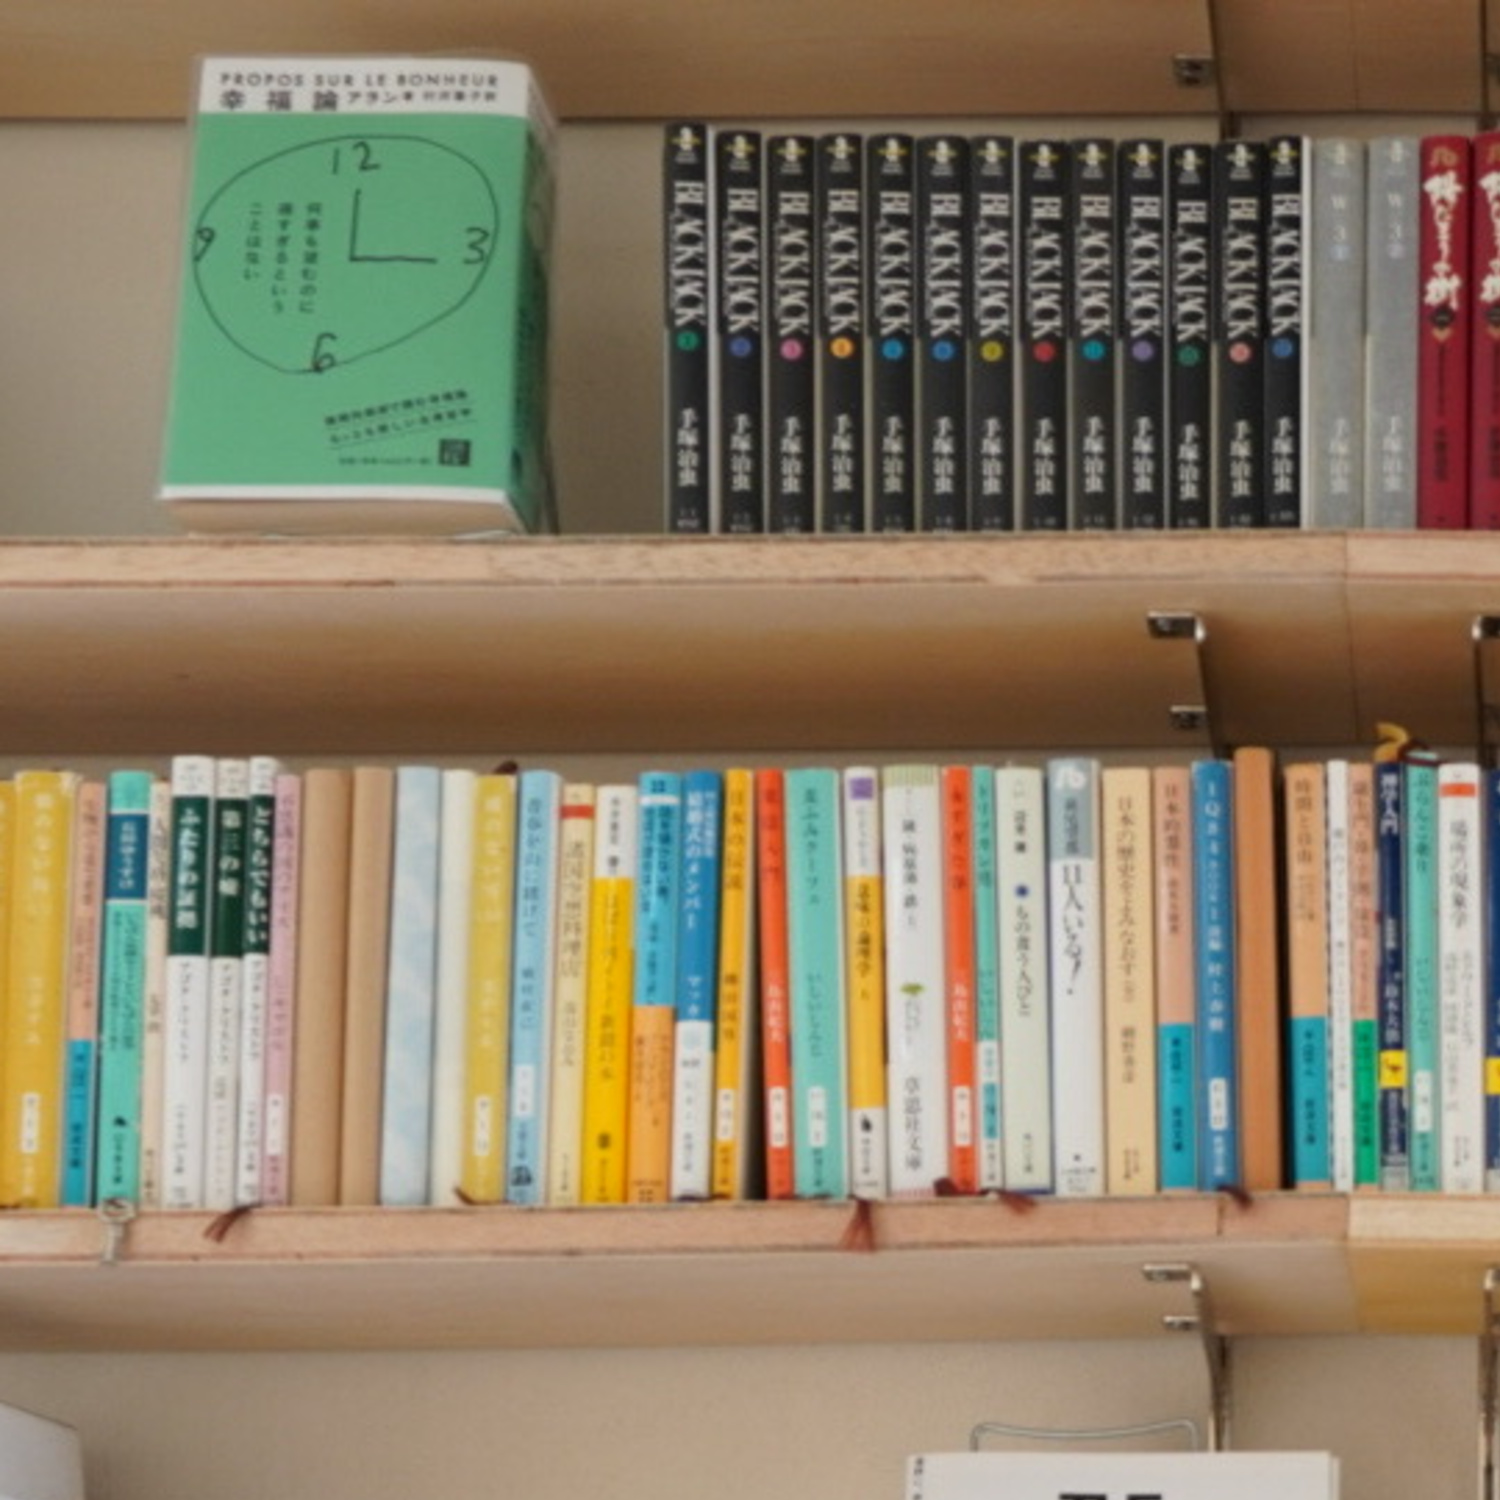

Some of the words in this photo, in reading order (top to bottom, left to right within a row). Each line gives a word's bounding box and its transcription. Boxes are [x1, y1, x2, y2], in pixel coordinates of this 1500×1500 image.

[220, 73, 303, 87] PROPOS
[313, 73, 354, 87] SUR
[365, 73, 387, 87] LE
[396, 73, 498, 87] BONHEUR
[220, 89, 338, 111] 幸福論
[332, 141, 381, 175] 12
[194, 228, 215, 262] 9
[243, 202, 262, 281] ことはない
[464, 228, 490, 265] 3
[312, 333, 338, 374] 6
[677, 408, 698, 486] 手塚治虫
[731, 414, 752, 492] 手塚治虫
[781, 416, 802, 494] 手塚治虫
[832, 414, 852, 492] 手塚治虫
[883, 416, 903, 492] 手塚治虫
[933, 416, 954, 494] 手塚治虫
[981, 417, 1002, 495] 手塚治虫
[1034, 418, 1054, 495] 手塚治虫
[1084, 416, 1105, 493] 手塚治虫
[1132, 416, 1153, 493] 手塚治虫
[1178, 424, 1198, 500] 手塚治虫
[1230, 420, 1251, 497] 手塚治虫
[1273, 417, 1294, 494] 手塚治虫
[1381, 773, 1398, 837] 禅学入門
[218, 809, 241, 897] 第三の嘘
[1013, 906, 1032, 1018] もの食う人びと
[1208, 962, 1224, 1032] 村上春樹
[903, 1076, 922, 1171] 草思社文庫
